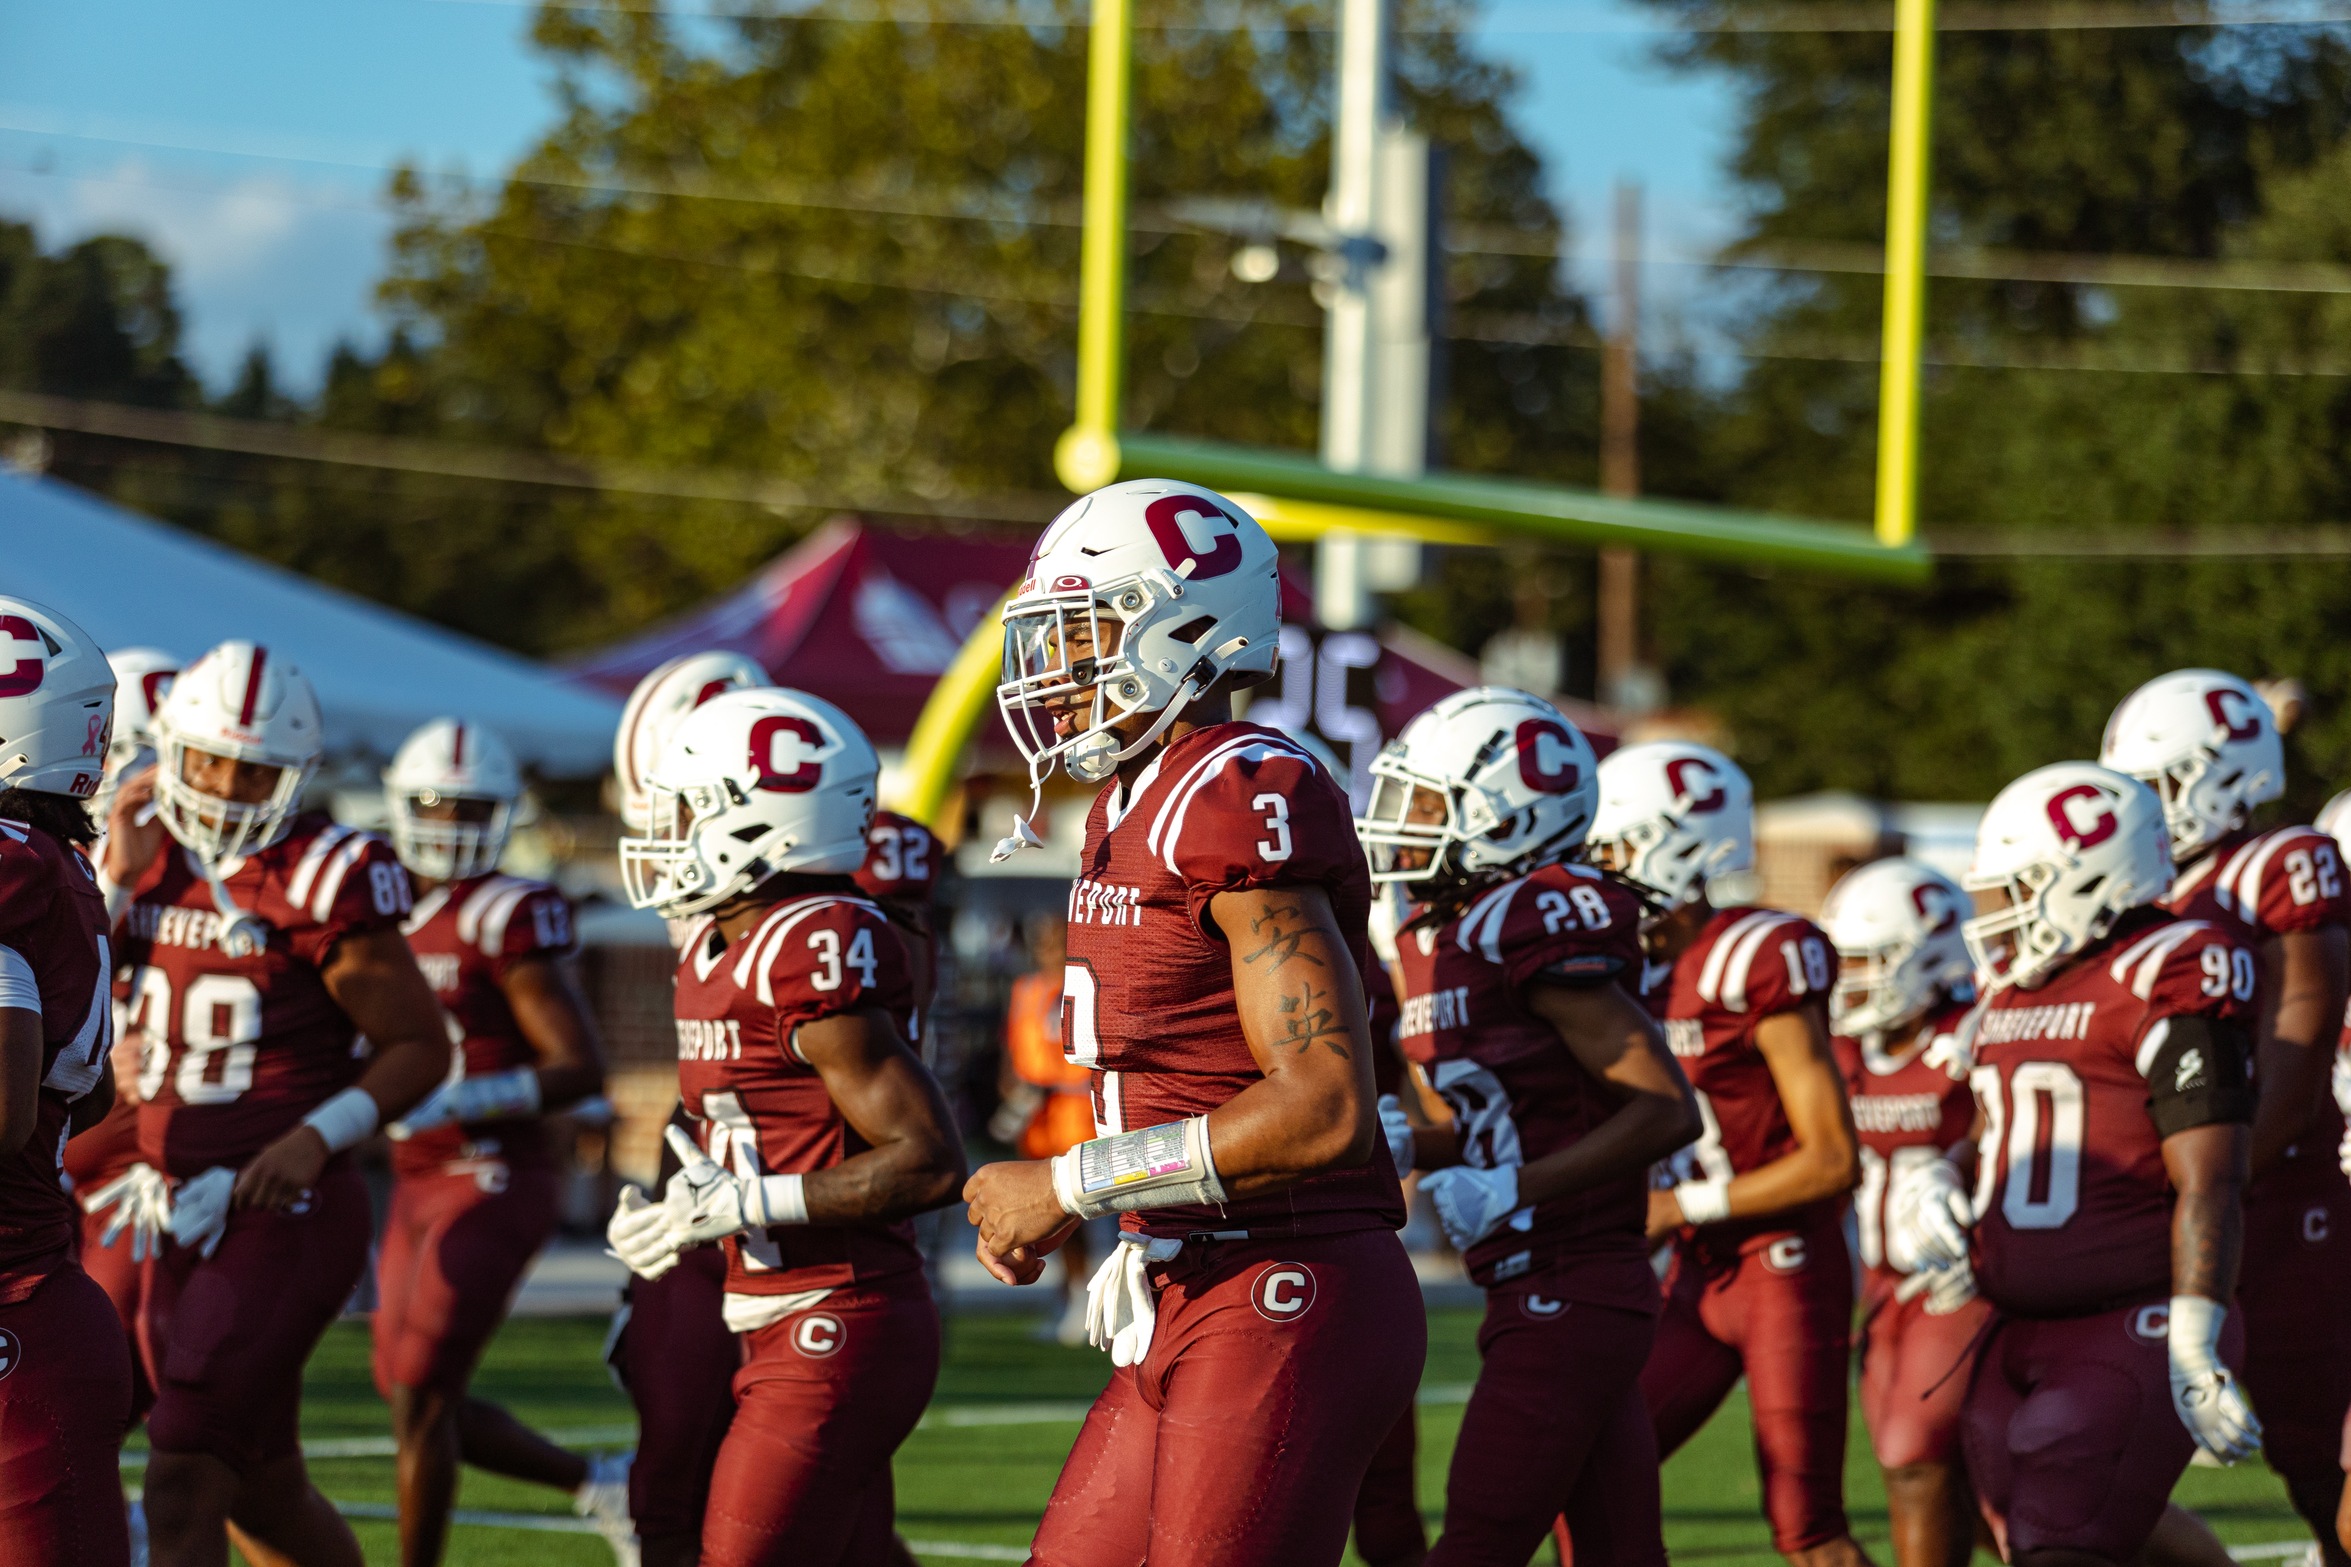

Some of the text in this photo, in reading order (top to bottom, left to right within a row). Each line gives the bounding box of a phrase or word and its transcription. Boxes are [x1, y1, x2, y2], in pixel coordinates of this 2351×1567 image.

[1145, 494, 1243, 581] C
[2206, 689, 2261, 743] C
[750, 716, 826, 793] C
[1516, 718, 1579, 794] C
[1666, 758, 1727, 814] C
[1251, 792, 1294, 863] 3
[2047, 784, 2119, 850] C
[869, 827, 930, 882] 32
[2284, 844, 2341, 906] 22
[1536, 884, 1613, 936] 28
[807, 928, 878, 992] 34
[1780, 936, 1830, 996] 18
[2200, 944, 2256, 1002] 90
[1769, 1236, 1806, 1270] C
[2303, 1208, 2329, 1241] C
[1262, 1264, 1305, 1313] C
[799, 1316, 838, 1352] C
[2136, 1304, 2169, 1339] C
